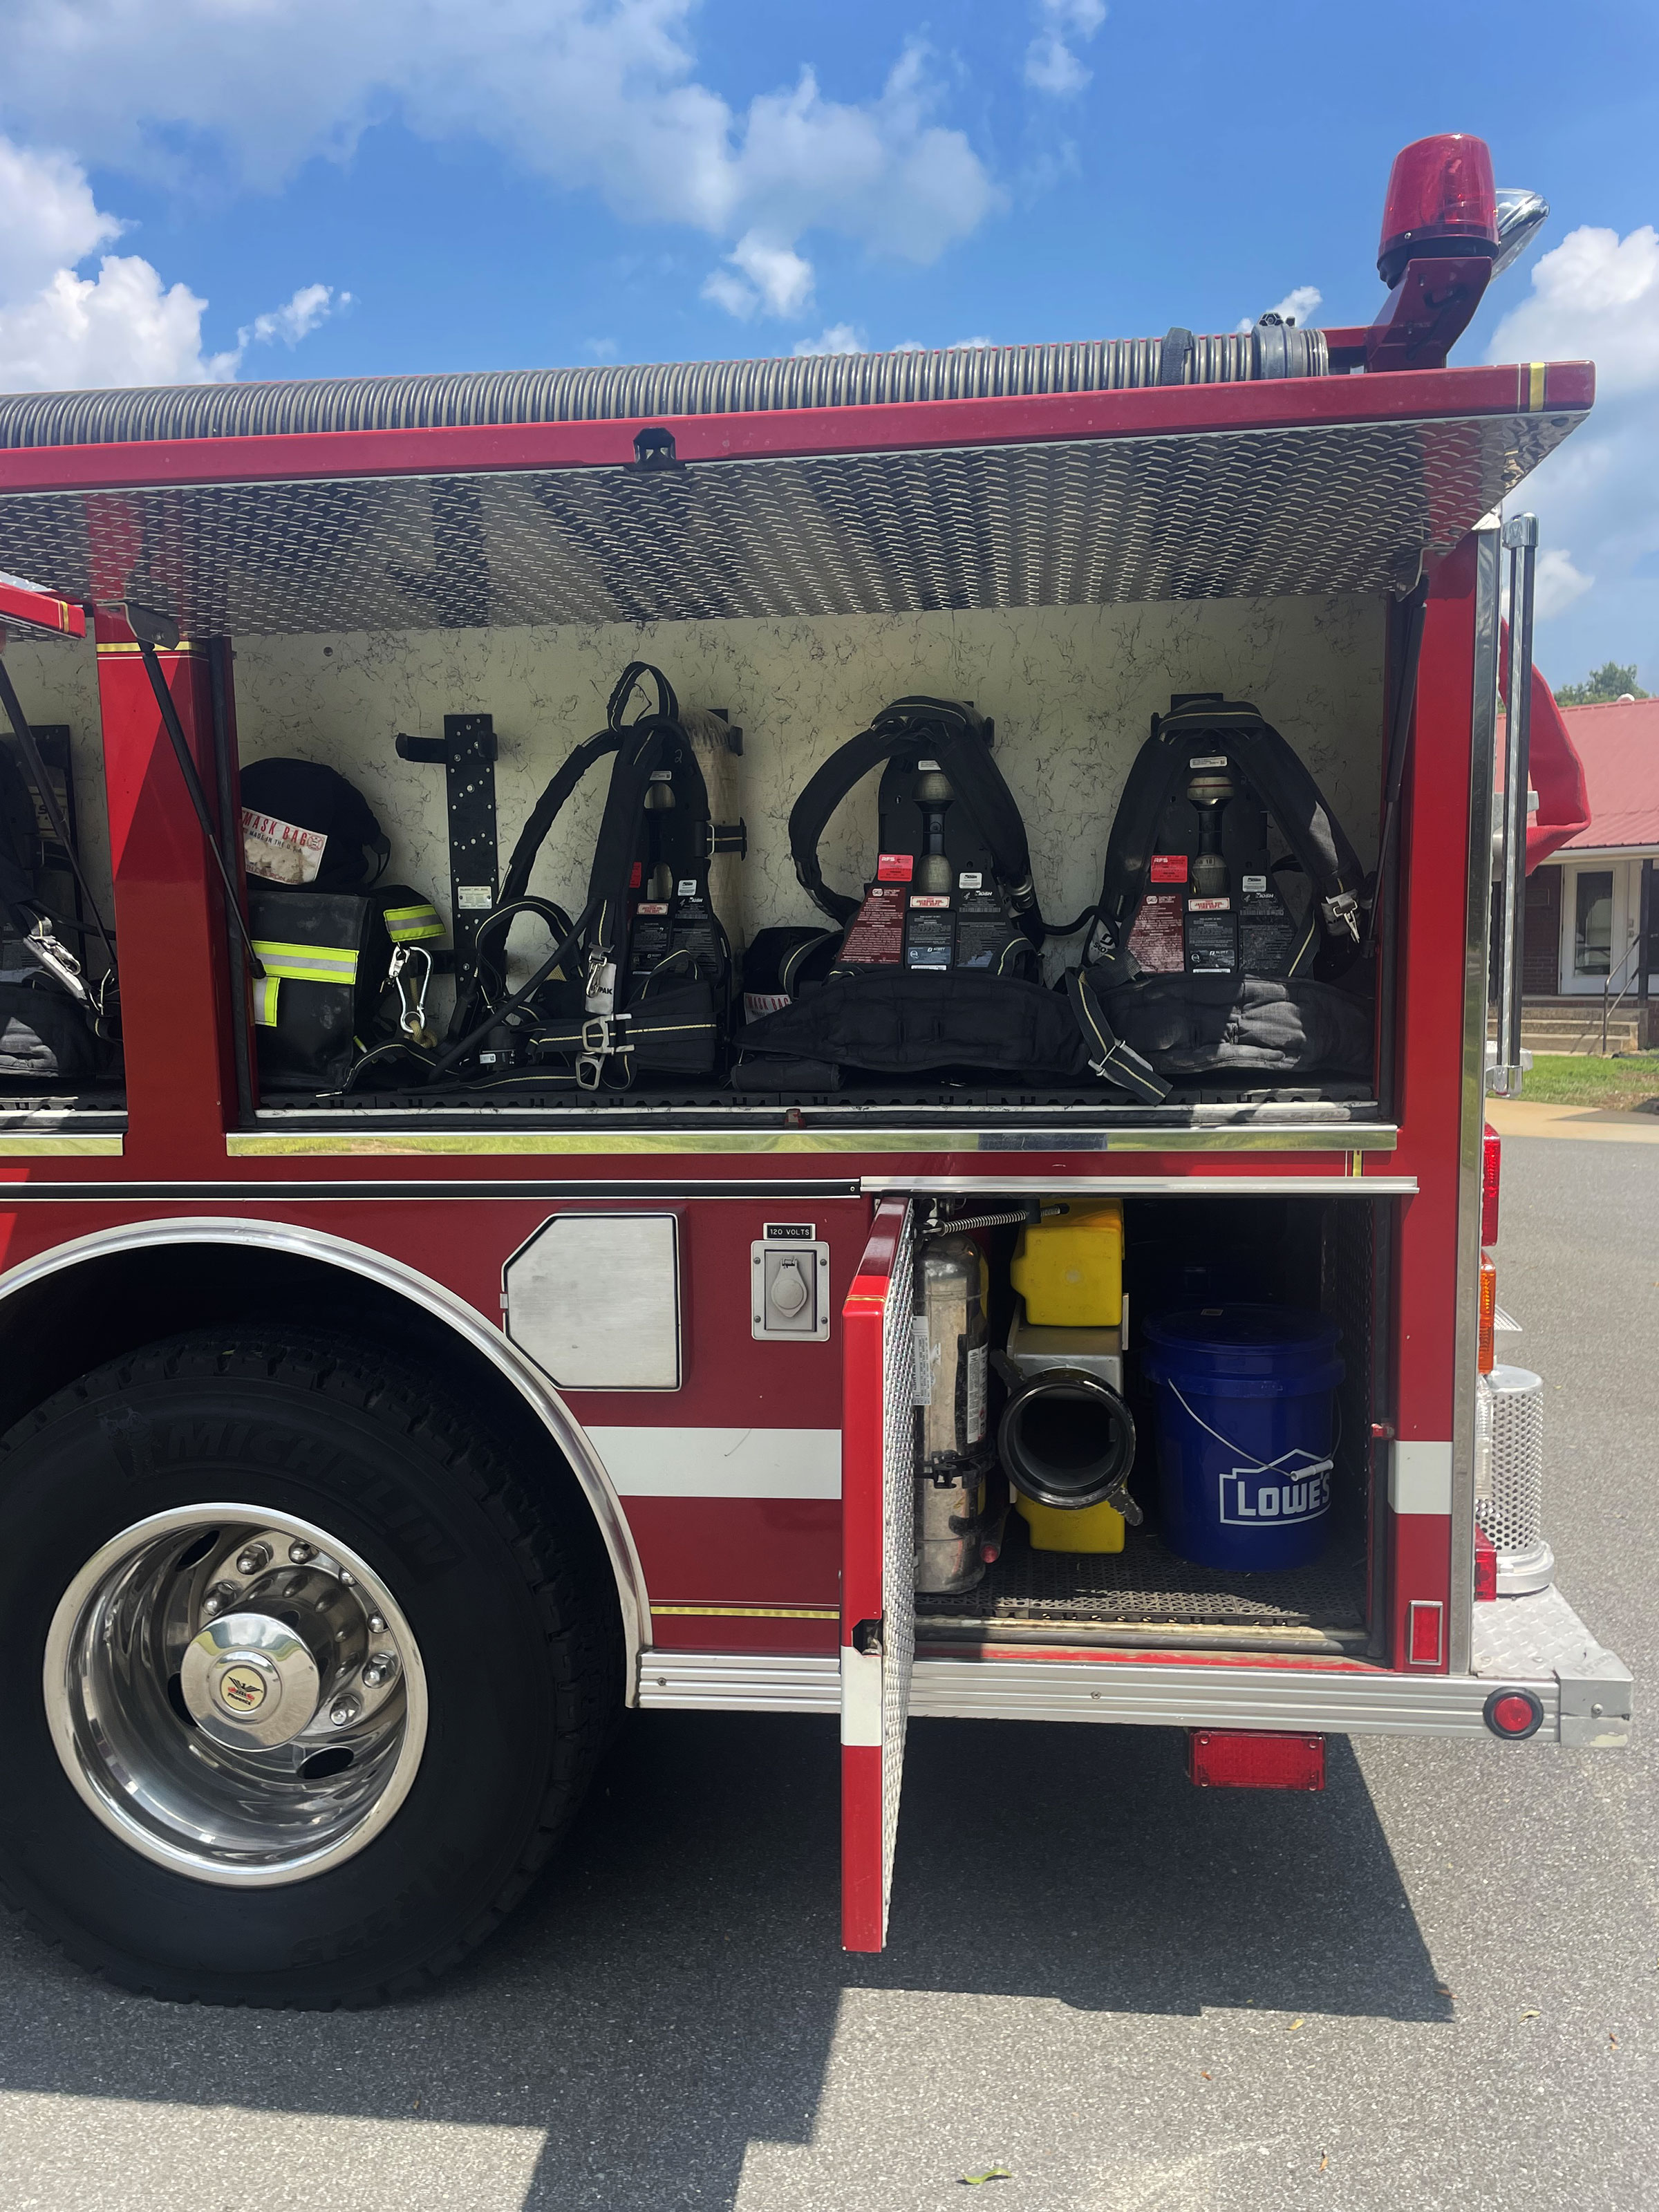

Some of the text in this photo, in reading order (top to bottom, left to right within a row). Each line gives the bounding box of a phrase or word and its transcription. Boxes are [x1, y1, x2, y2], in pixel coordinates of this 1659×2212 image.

[243, 812, 308, 847] MASK BAG
[250, 830, 264, 840] MADE
[275, 839, 284, 847] THE
[748, 996, 769, 1011] MASK
[165, 1419, 467, 1569] MICHELIN
[1237, 1471, 1330, 1517] LOWE'S
